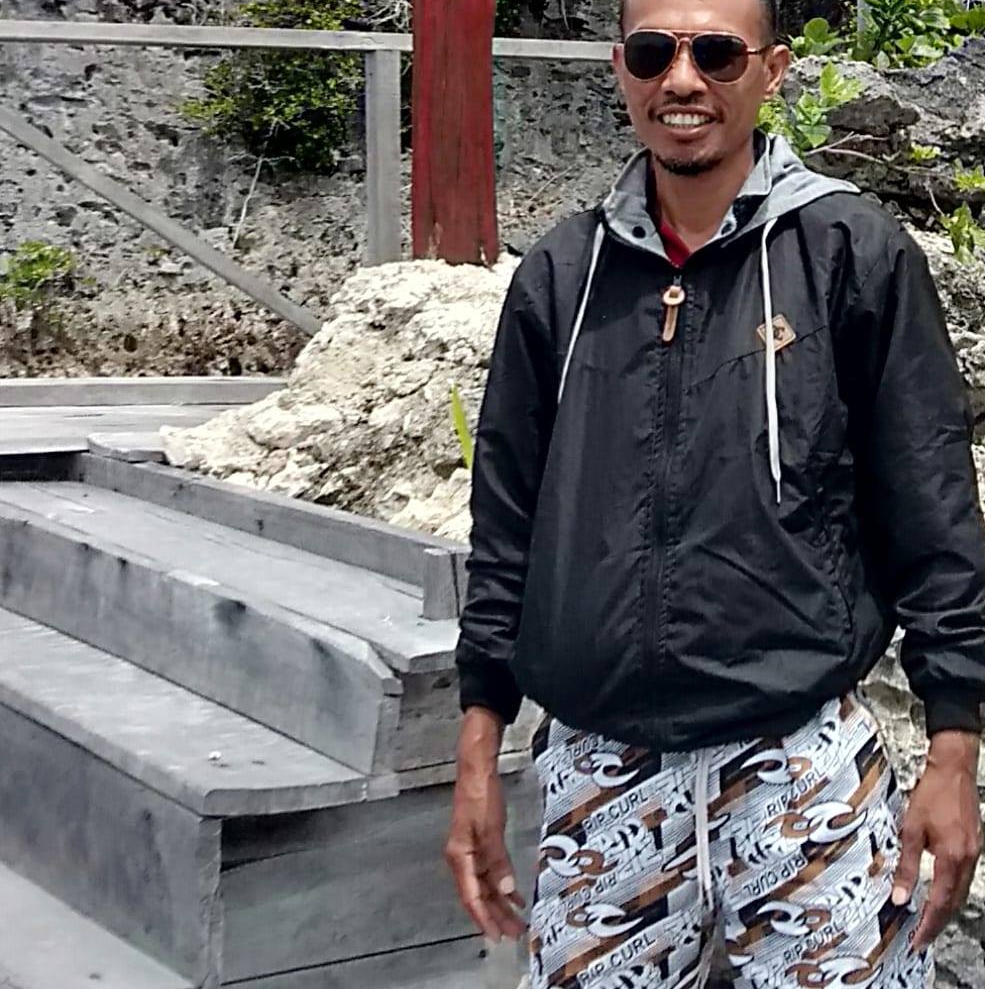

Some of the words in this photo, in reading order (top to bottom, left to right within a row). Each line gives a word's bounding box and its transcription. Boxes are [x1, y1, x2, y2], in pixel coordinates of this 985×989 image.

[608, 788, 649, 820] CURL
[743, 873, 779, 897] CURL
[610, 933, 656, 968] CURL
